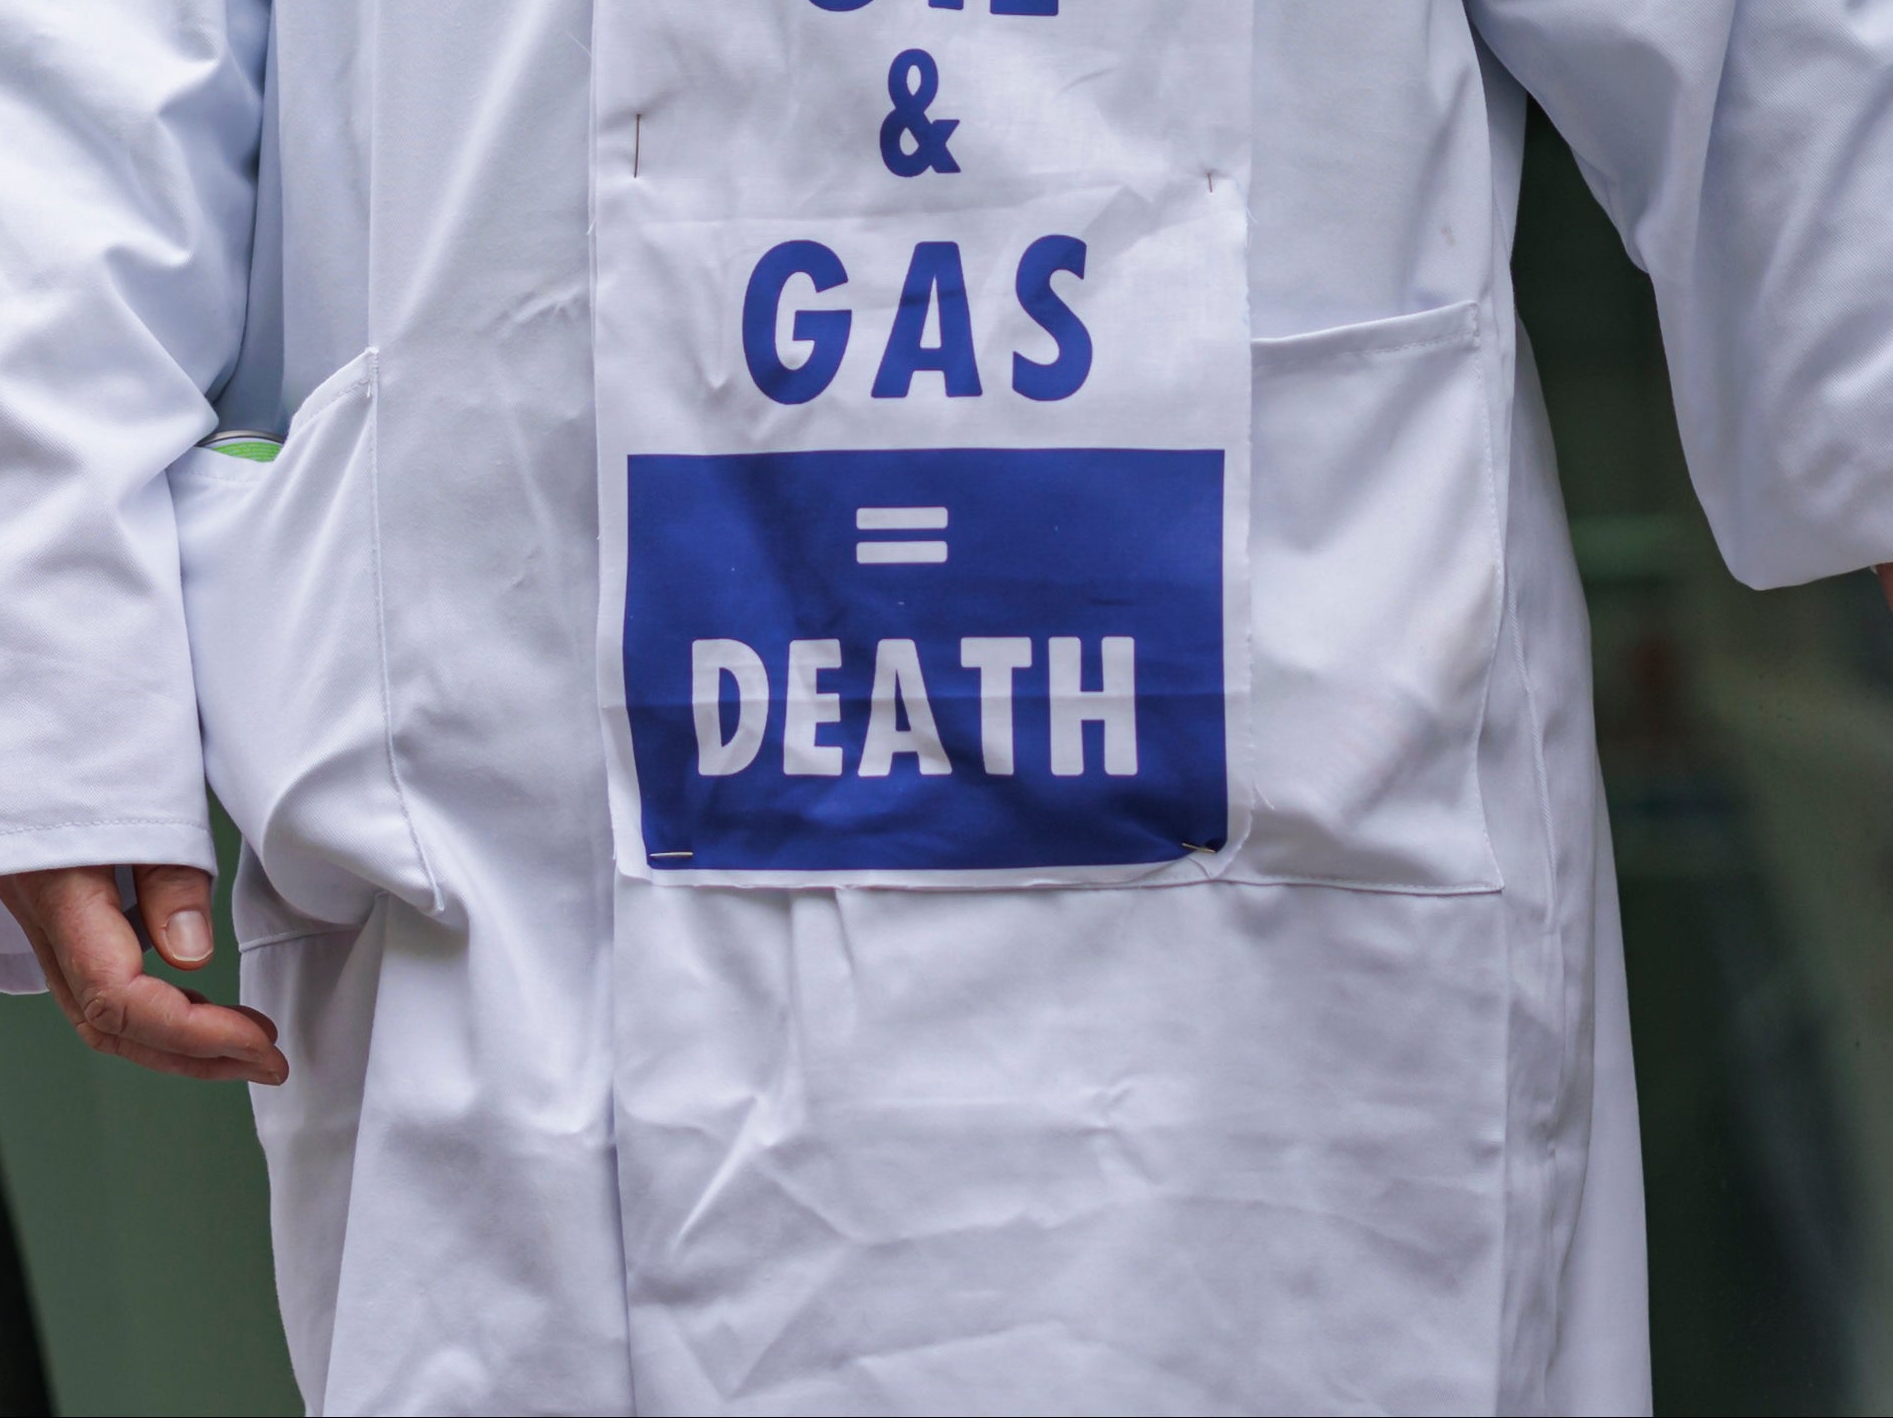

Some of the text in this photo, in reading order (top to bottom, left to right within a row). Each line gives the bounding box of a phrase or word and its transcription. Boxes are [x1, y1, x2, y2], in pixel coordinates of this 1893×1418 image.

[884, 50, 956, 175] &
[744, 236, 1092, 403] GAS
[855, 506, 949, 565] =
[680, 635, 1139, 792] DEATH
